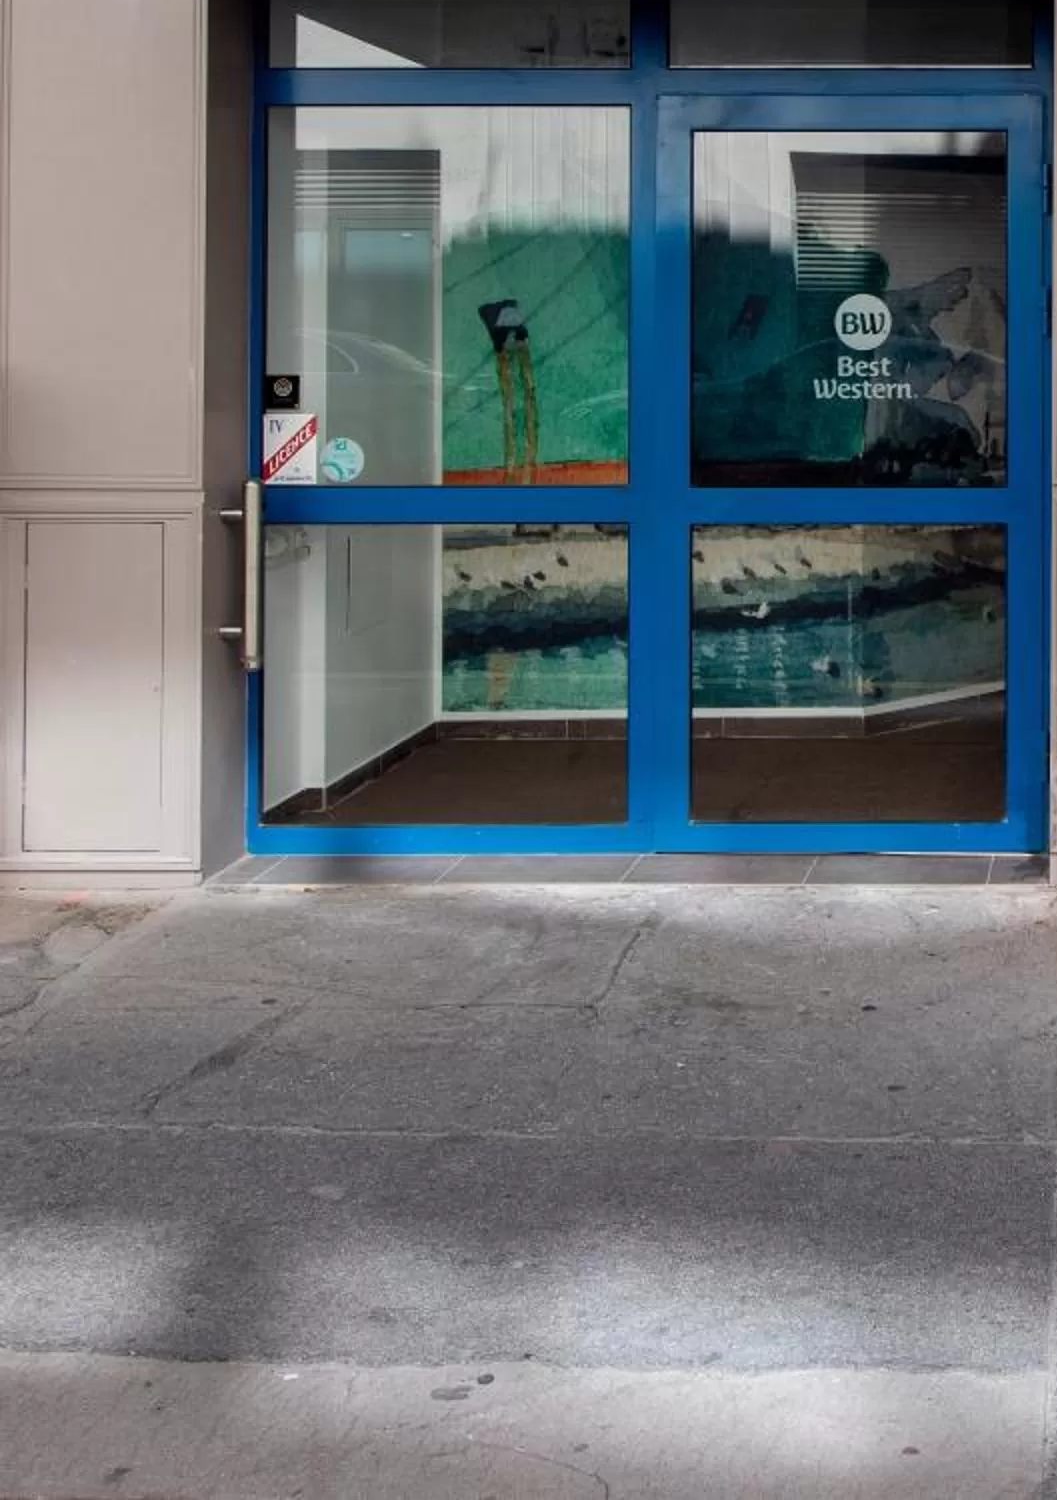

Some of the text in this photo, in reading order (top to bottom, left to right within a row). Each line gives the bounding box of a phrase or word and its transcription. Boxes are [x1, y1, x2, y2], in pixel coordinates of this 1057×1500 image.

[841, 311, 885, 335] BW
[836, 355, 893, 378] Best
[813, 377, 913, 400] Western
[268, 422, 314, 474] LICENCE
